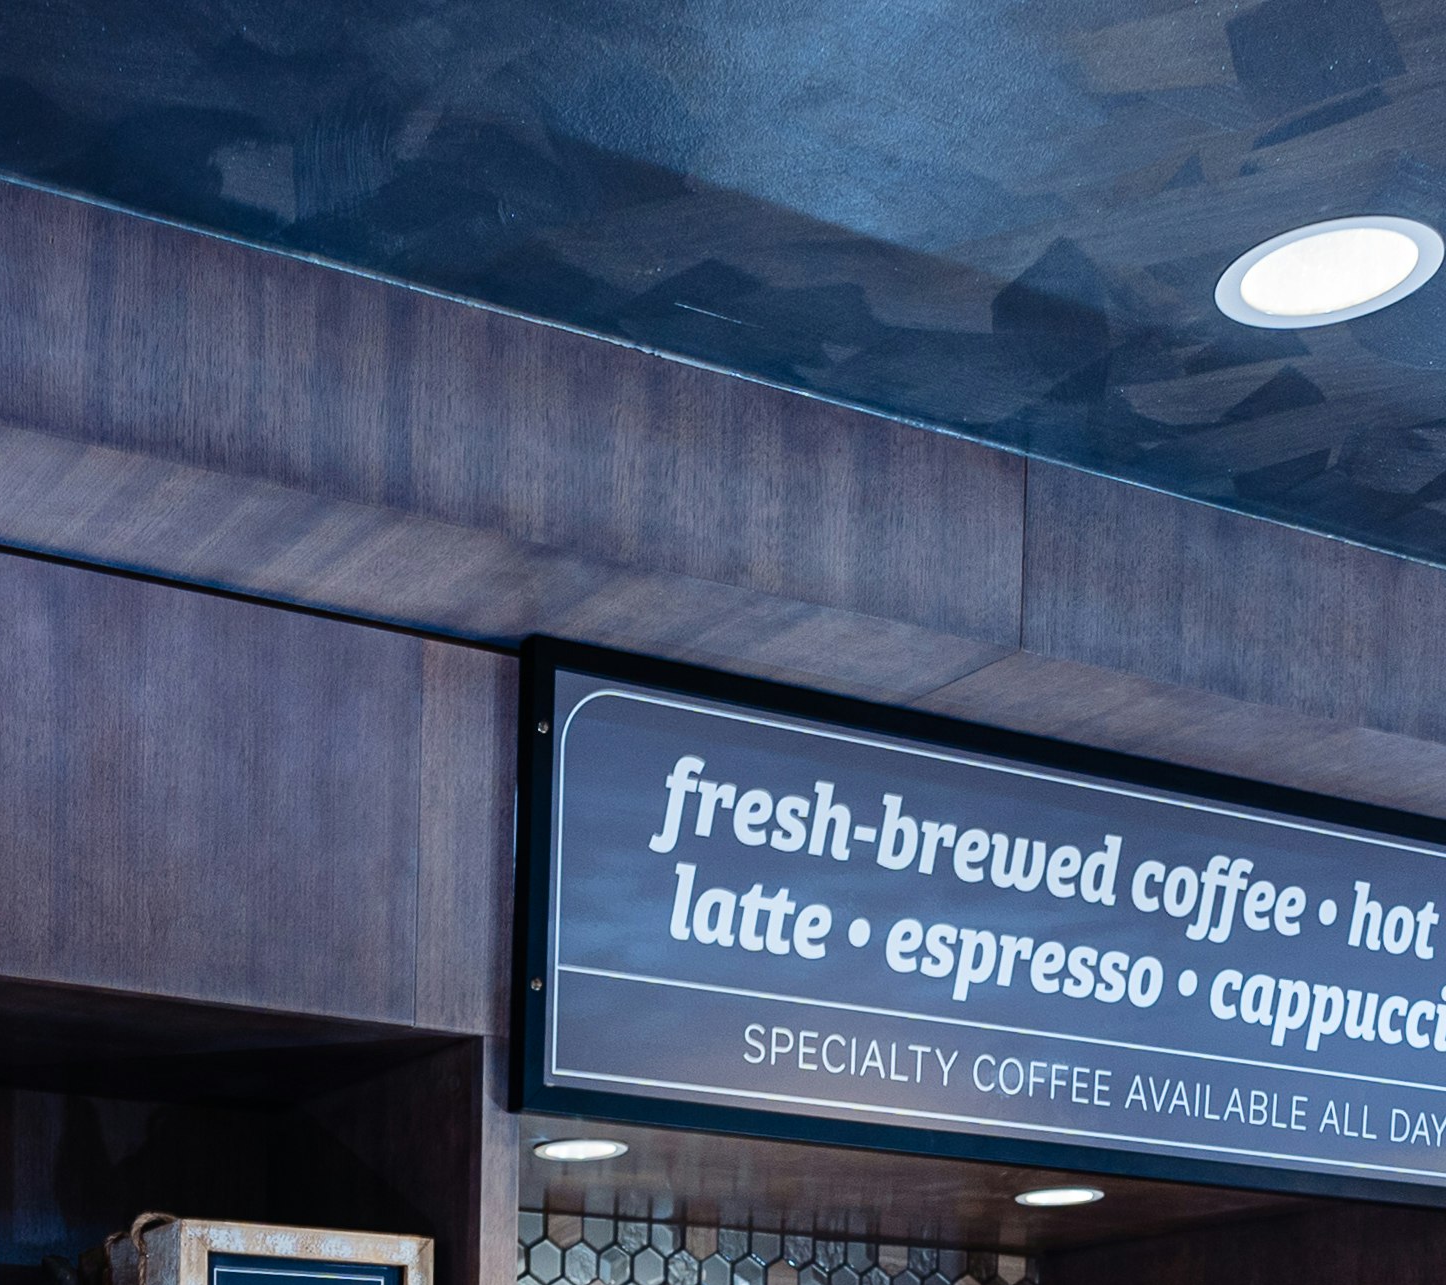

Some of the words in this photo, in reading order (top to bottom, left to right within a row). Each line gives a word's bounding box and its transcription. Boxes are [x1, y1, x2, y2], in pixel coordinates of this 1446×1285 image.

[648, 755, 1123, 906] fresh-brewed
[1131, 855, 1308, 943] coffee
[1347, 880, 1440, 960] hot
[668, 861, 833, 959] latte
[885, 917, 1164, 1008] espresso
[742, 1023, 959, 1087] SPECIALTY
[972, 1053, 1112, 1108] COFFEE
[1124, 1074, 1308, 1132] AVAILABLE
[1319, 1099, 1377, 1141] ALL
